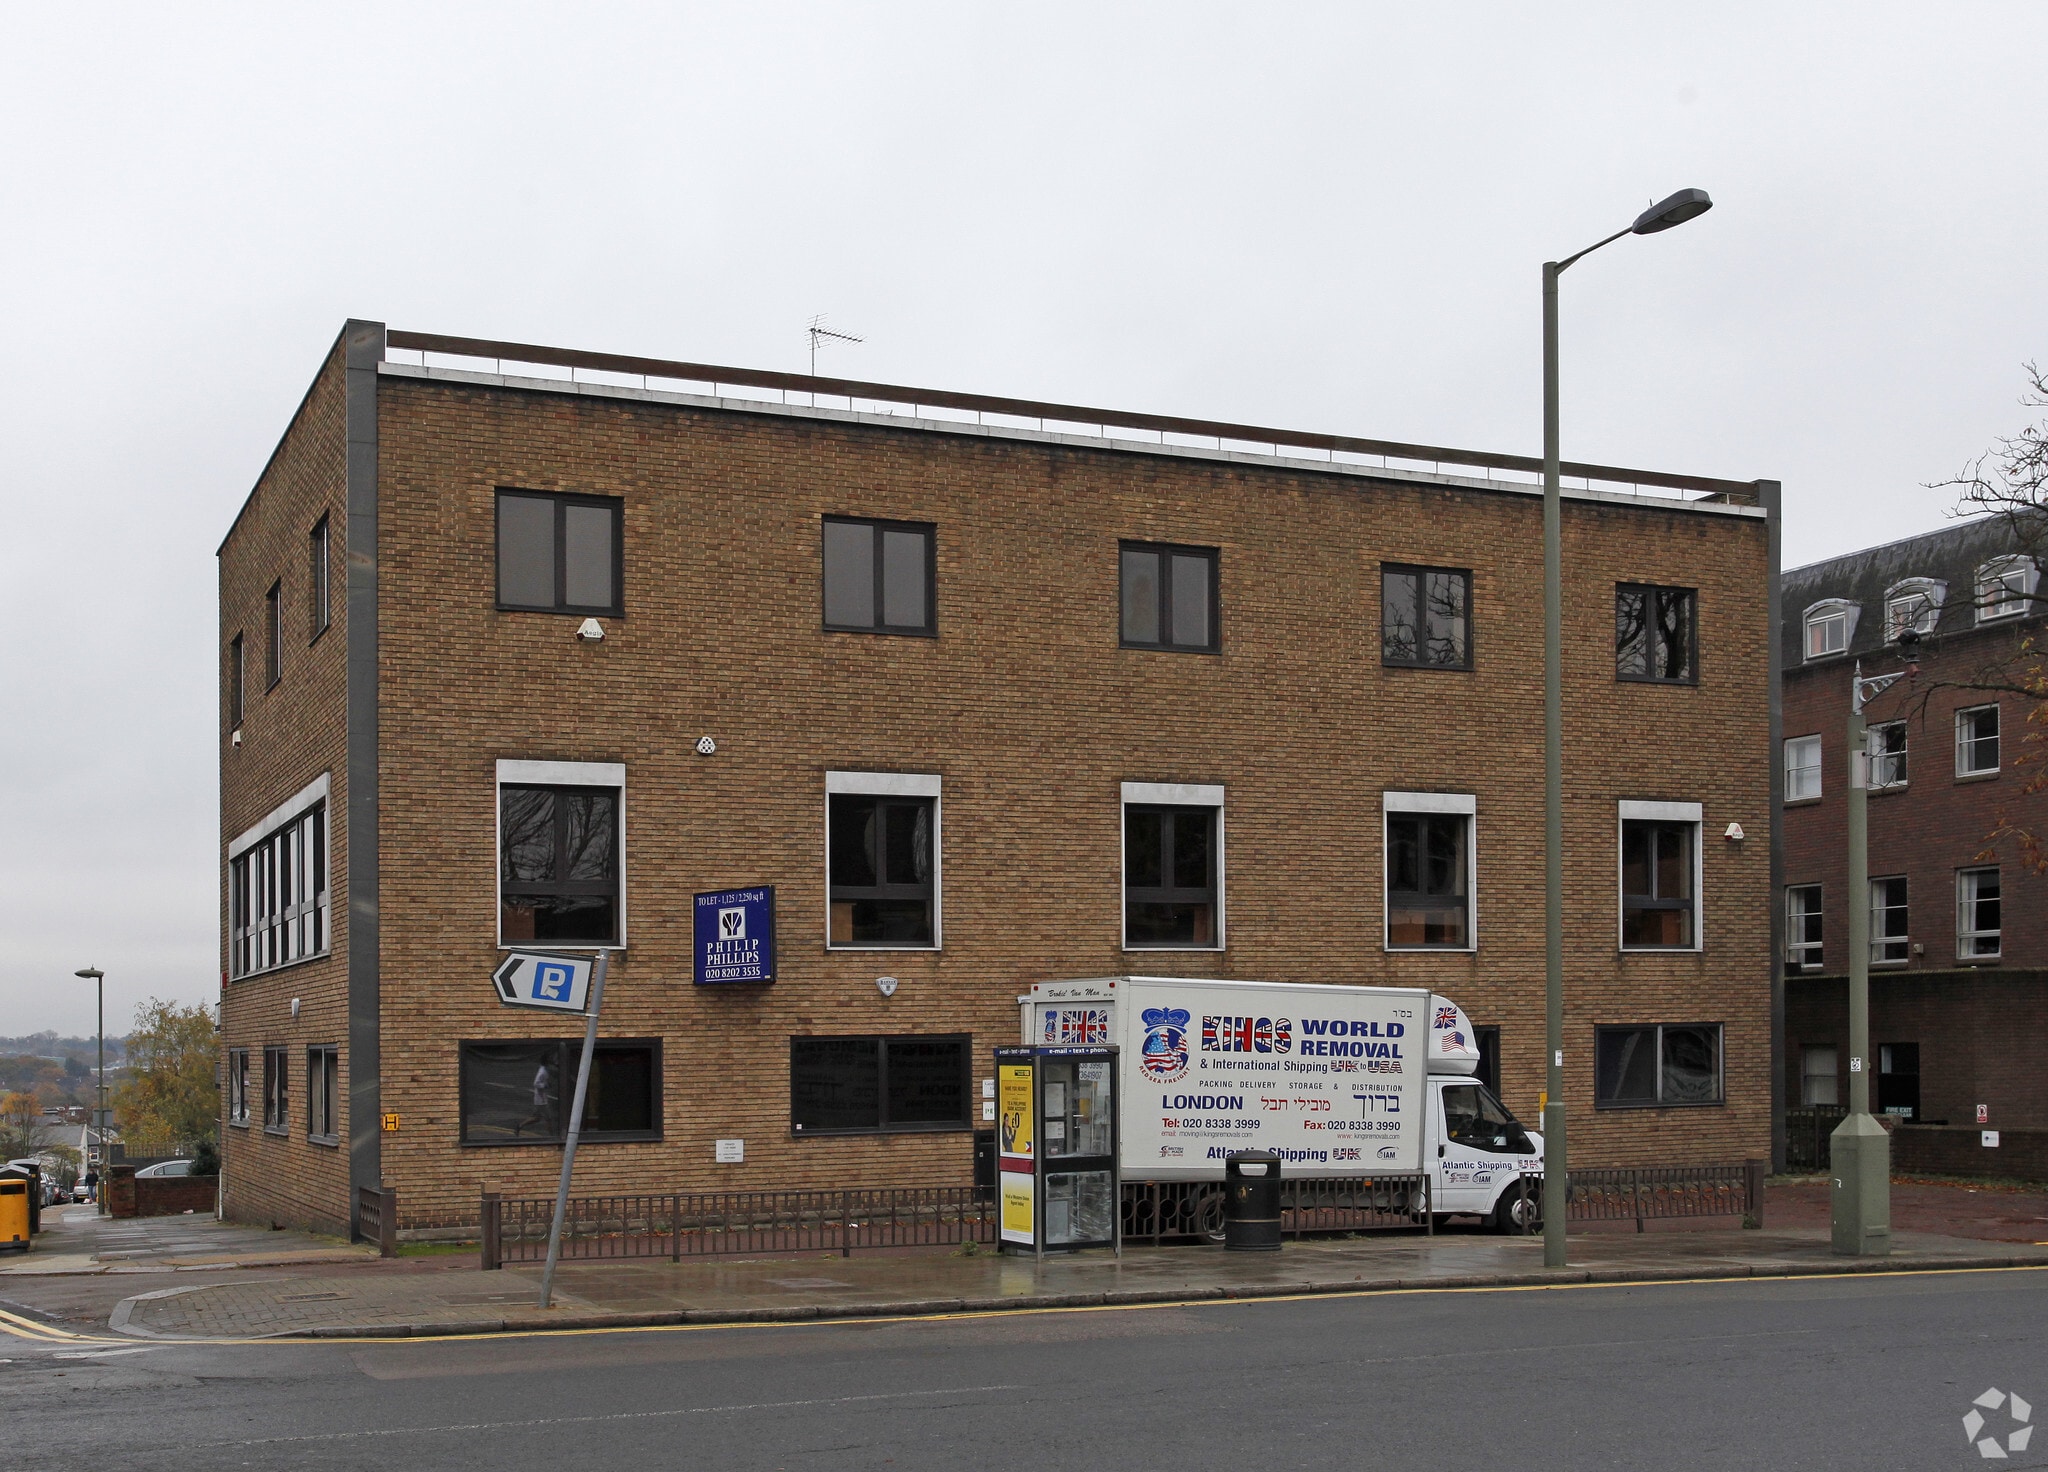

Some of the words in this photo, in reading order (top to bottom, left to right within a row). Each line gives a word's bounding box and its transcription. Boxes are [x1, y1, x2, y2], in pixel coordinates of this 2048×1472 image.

[698, 897, 707, 906] TO
[706, 896, 717, 906] LET
[721, 894, 735, 904] 1,125
[738, 892, 752, 904] 2,250
[752, 894, 759, 902] sq
[759, 891, 764, 900] ft
[706, 938, 759, 954] PHILIP
[706, 951, 760, 965] PHILLIPS
[705, 969, 720, 979] 020
[721, 967, 740, 977] 8202
[742, 966, 761, 977] 3535
[540, 967, 566, 996] P
[1071, 989, 1081, 997] Van
[1085, 988, 1100, 996] Man
[1201, 1015, 1293, 1055] KINGS
[1301, 1019, 1405, 1038] WORLD
[1300, 1040, 1404, 1059] REMOVAL
[1200, 1058, 1208, 1069] &
[1212, 1058, 1280, 1071] International
[1284, 1060, 1328, 1075] Shipping
[1330, 1060, 1360, 1073] UK
[1360, 1062, 1367, 1070] to
[1367, 1061, 1404, 1074] USA
[1148, 1075, 1161, 1084] SEA
[1163, 1067, 1191, 1084] FREIGHT
[1199, 1080, 1233, 1089] PACKING
[1239, 1081, 1277, 1089] DELIVERY
[1289, 1082, 1323, 1090] STORAGE
[1352, 1083, 1403, 1092] DISTRIBUTION
[1162, 1095, 1243, 1110] LONDON
[1260, 1095, 1288, 1111] תבל
[1293, 1096, 1331, 1111] מובילי
[1353, 1094, 1400, 1119] ברוך
[385, 1115, 397, 1130] H
[1162, 1118, 1180, 1128] Tel:
[1182, 1119, 1202, 1128] 020
[1205, 1119, 1231, 1129] 8338
[1234, 1119, 1260, 1129] 3999
[1304, 1120, 1326, 1130] Fax:
[1327, 1120, 1346, 1130] 020
[1348, 1121, 1373, 1130] 8338
[1376, 1121, 1400, 1131] 3990
[1333, 1148, 1361, 1160] UK
[1442, 1161, 1475, 1169] Atlantic
[1477, 1161, 1513, 1170] Shipping
